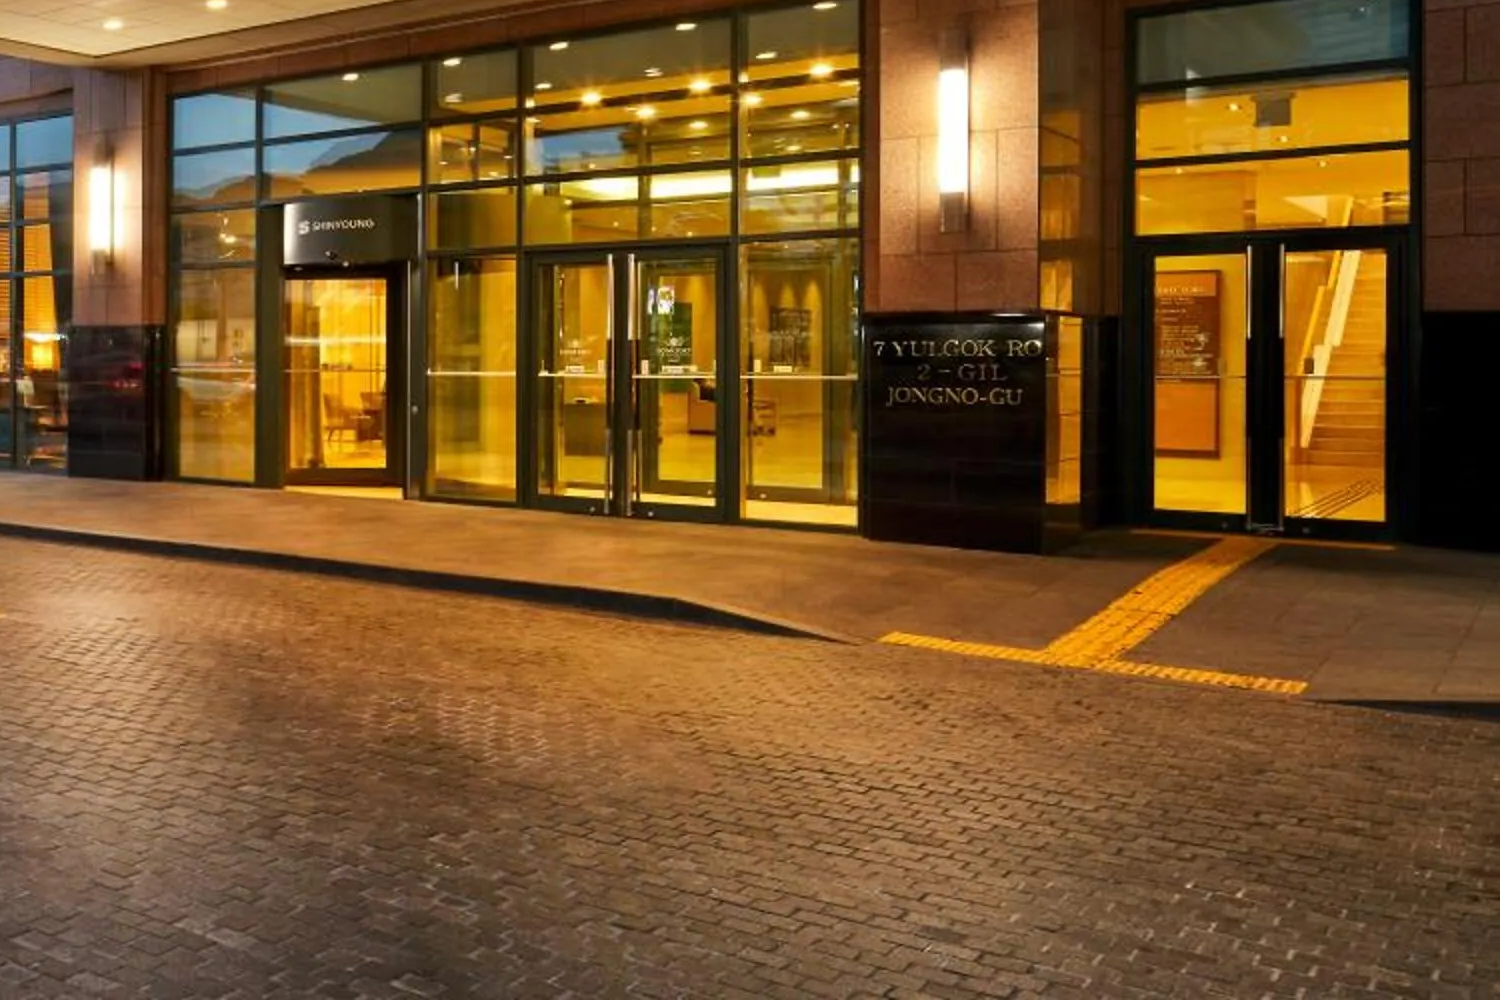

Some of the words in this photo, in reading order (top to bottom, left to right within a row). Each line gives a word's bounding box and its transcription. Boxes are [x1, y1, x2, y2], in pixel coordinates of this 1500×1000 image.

[873, 341, 885, 356] 7
[891, 339, 996, 357] YULGOK
[1007, 339, 1043, 357] RO
[886, 386, 1023, 406] JONGNO-GU
